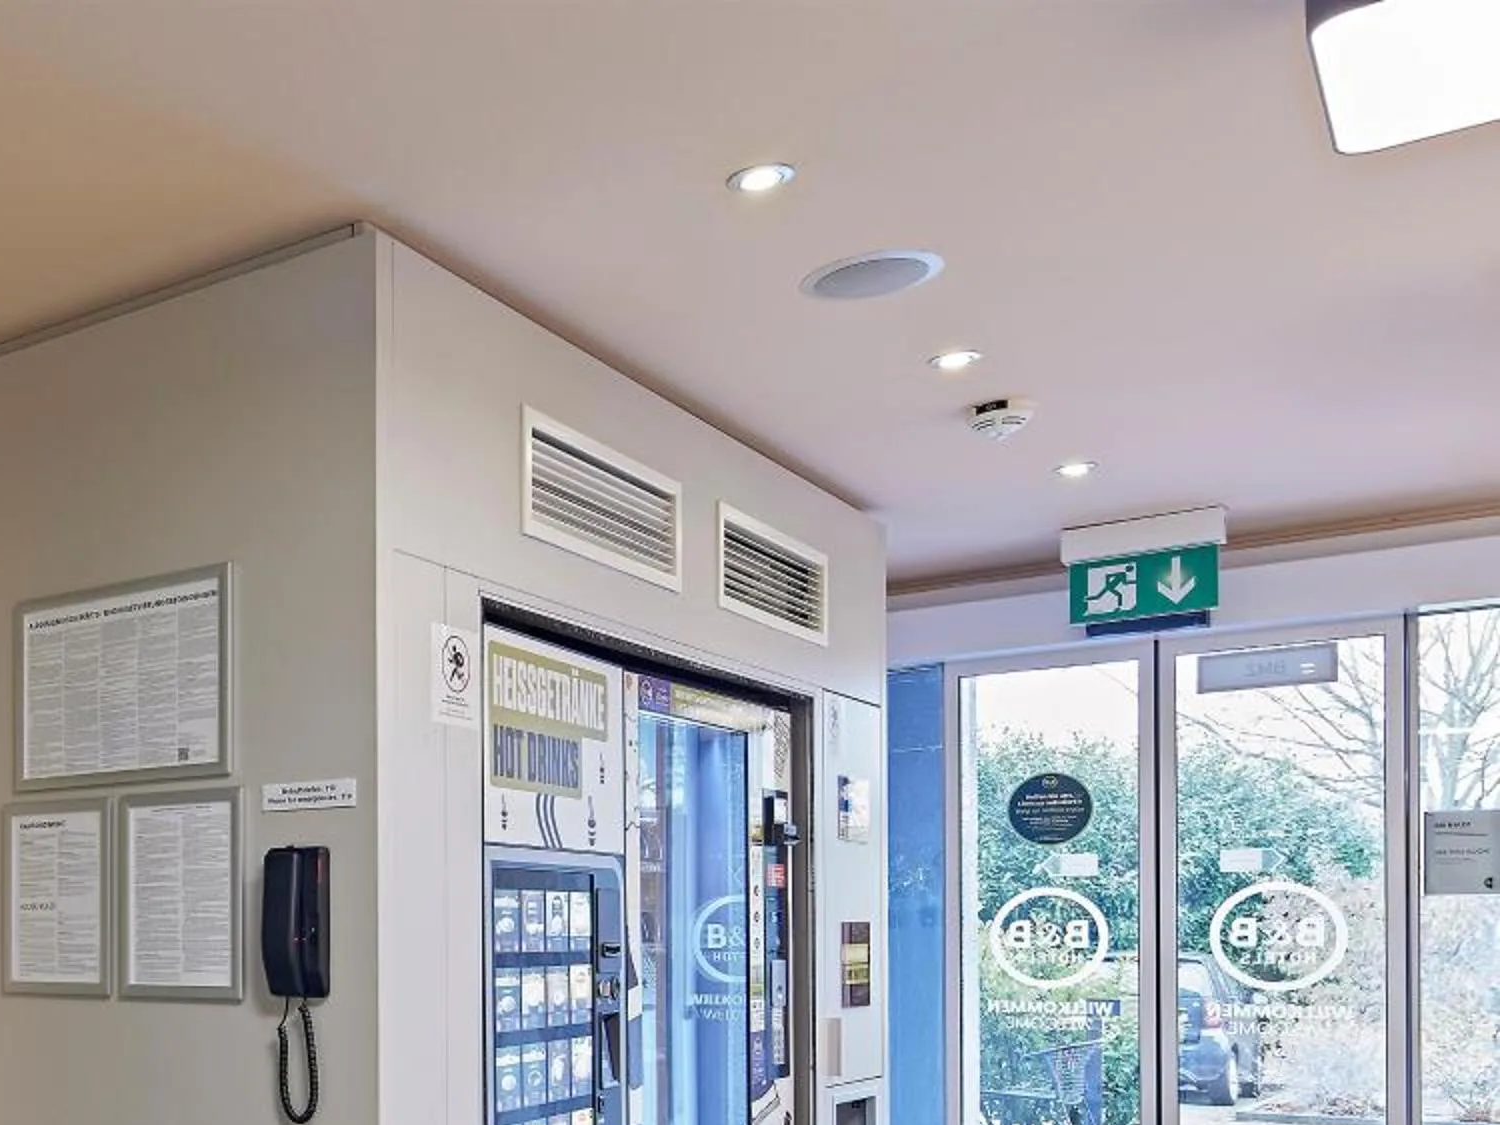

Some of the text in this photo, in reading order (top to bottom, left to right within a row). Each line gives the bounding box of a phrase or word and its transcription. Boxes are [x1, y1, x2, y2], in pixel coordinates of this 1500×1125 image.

[492, 652, 605, 732] HEISSGETRÄNKE
[492, 723, 579, 789] HOT DRINKS
